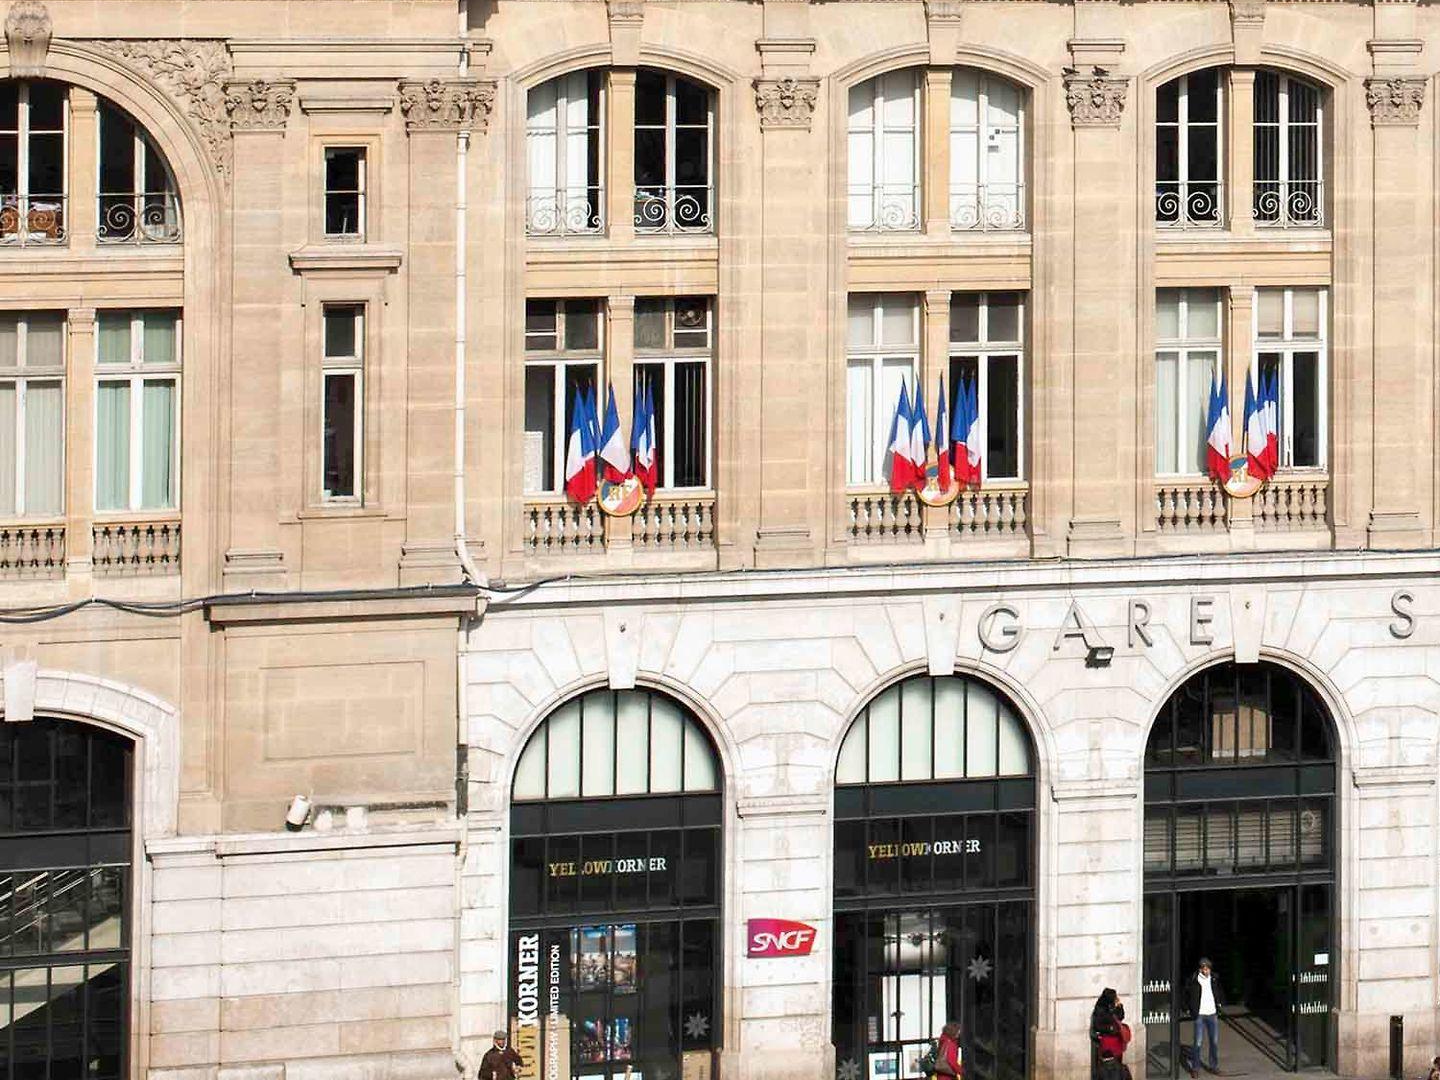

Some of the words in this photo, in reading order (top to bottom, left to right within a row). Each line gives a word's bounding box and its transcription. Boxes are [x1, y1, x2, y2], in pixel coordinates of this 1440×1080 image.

[978, 597, 1214, 653] GARE
[750, 929, 814, 952] SNCF
[550, 944, 560, 984] EDITION
